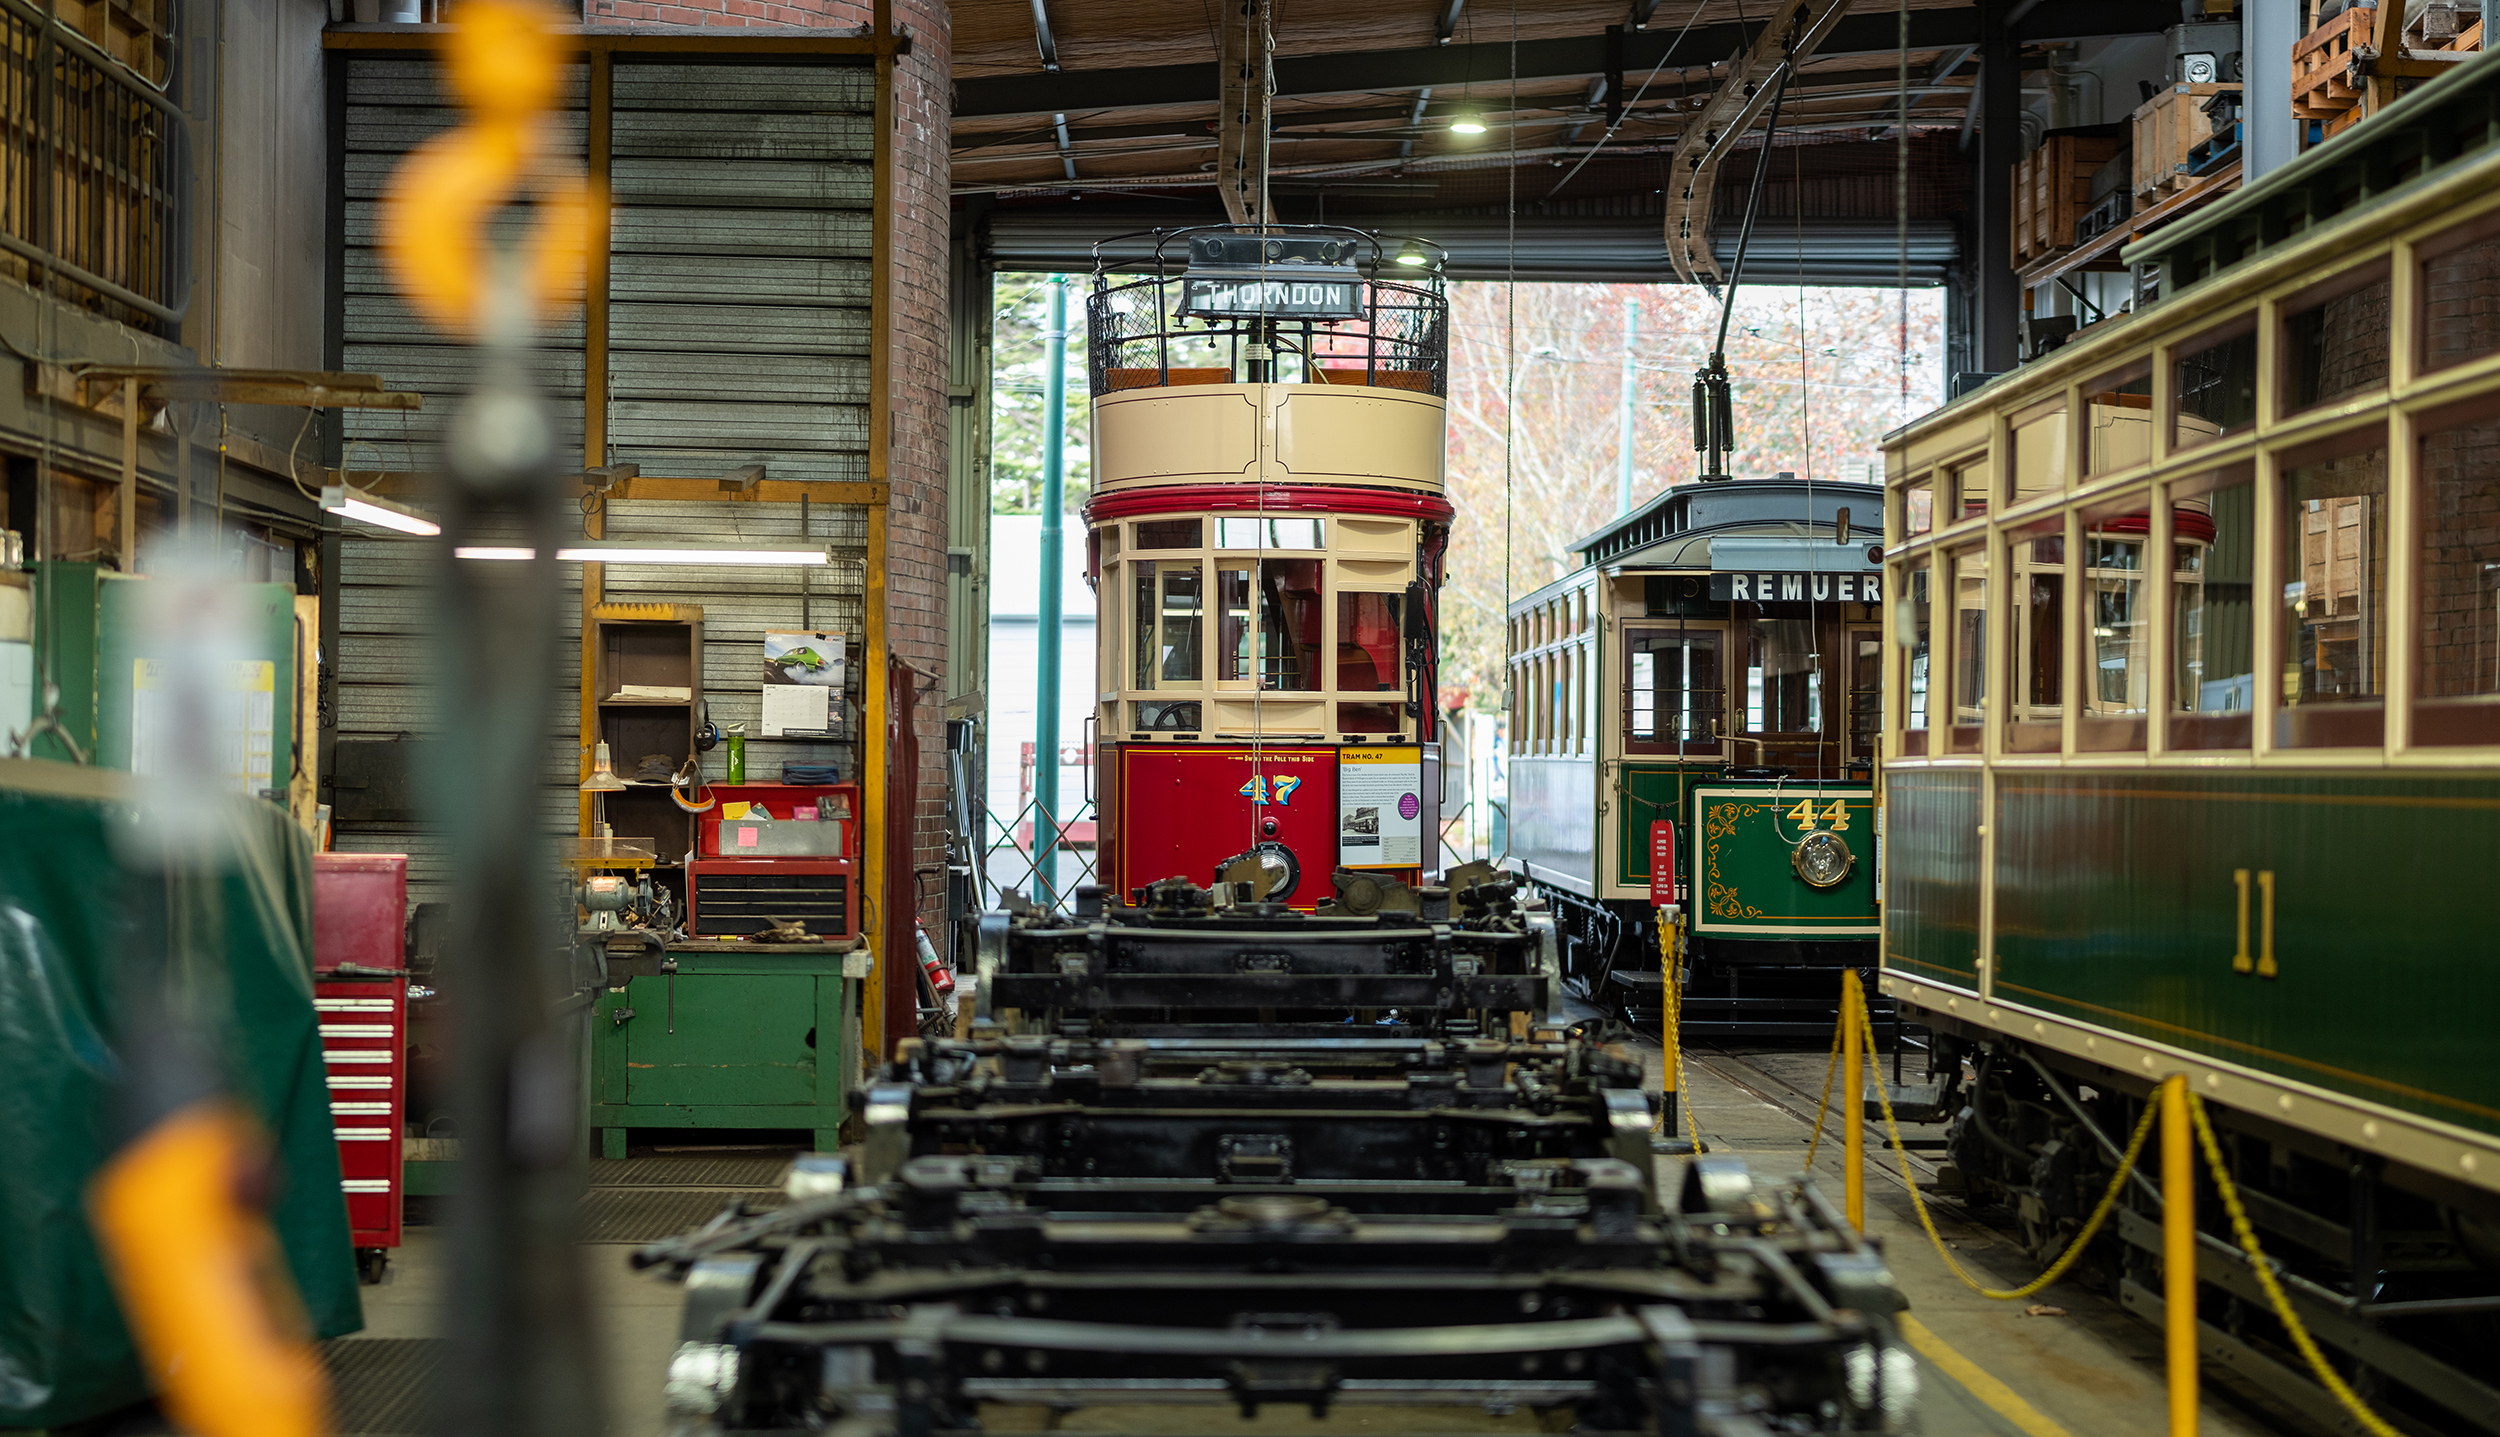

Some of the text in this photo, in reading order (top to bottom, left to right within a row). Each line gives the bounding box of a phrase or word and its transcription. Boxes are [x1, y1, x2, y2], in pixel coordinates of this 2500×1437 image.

[1207, 284, 1341, 306] THORNDON
[1732, 574, 1881, 601] REMUER
[1239, 774, 1302, 806] 47
[1786, 798, 1852, 832] 44
[2232, 868, 2278, 979] 11
